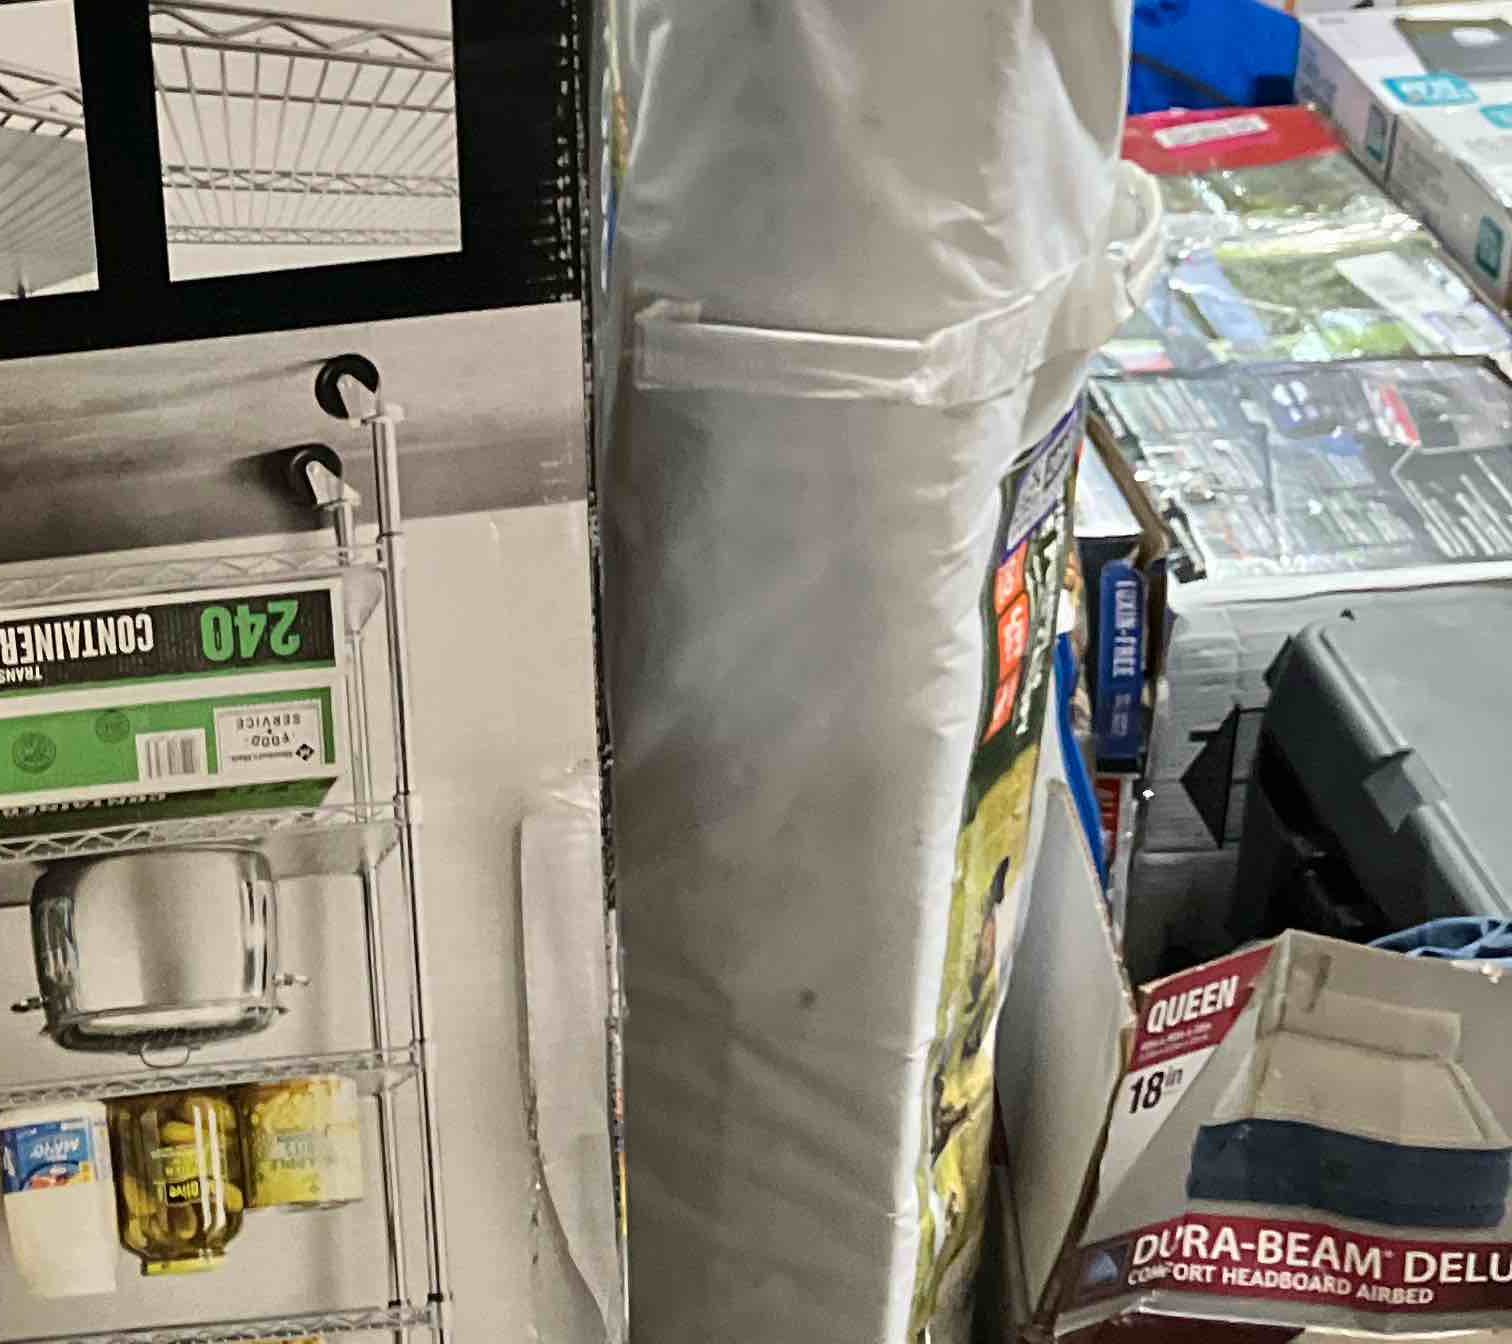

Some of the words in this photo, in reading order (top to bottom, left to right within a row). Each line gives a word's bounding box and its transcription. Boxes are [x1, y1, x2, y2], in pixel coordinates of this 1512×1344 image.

[200, 600, 300, 662] 240
[1146, 975, 1241, 1036] QUEEN
[1132, 1223, 1381, 1281] DURA-BEAM
[1404, 1251, 1512, 1285] DELU
[1222, 1267, 1352, 1295] HEADBOARD
[1355, 1283, 1435, 1305] AIRBED
